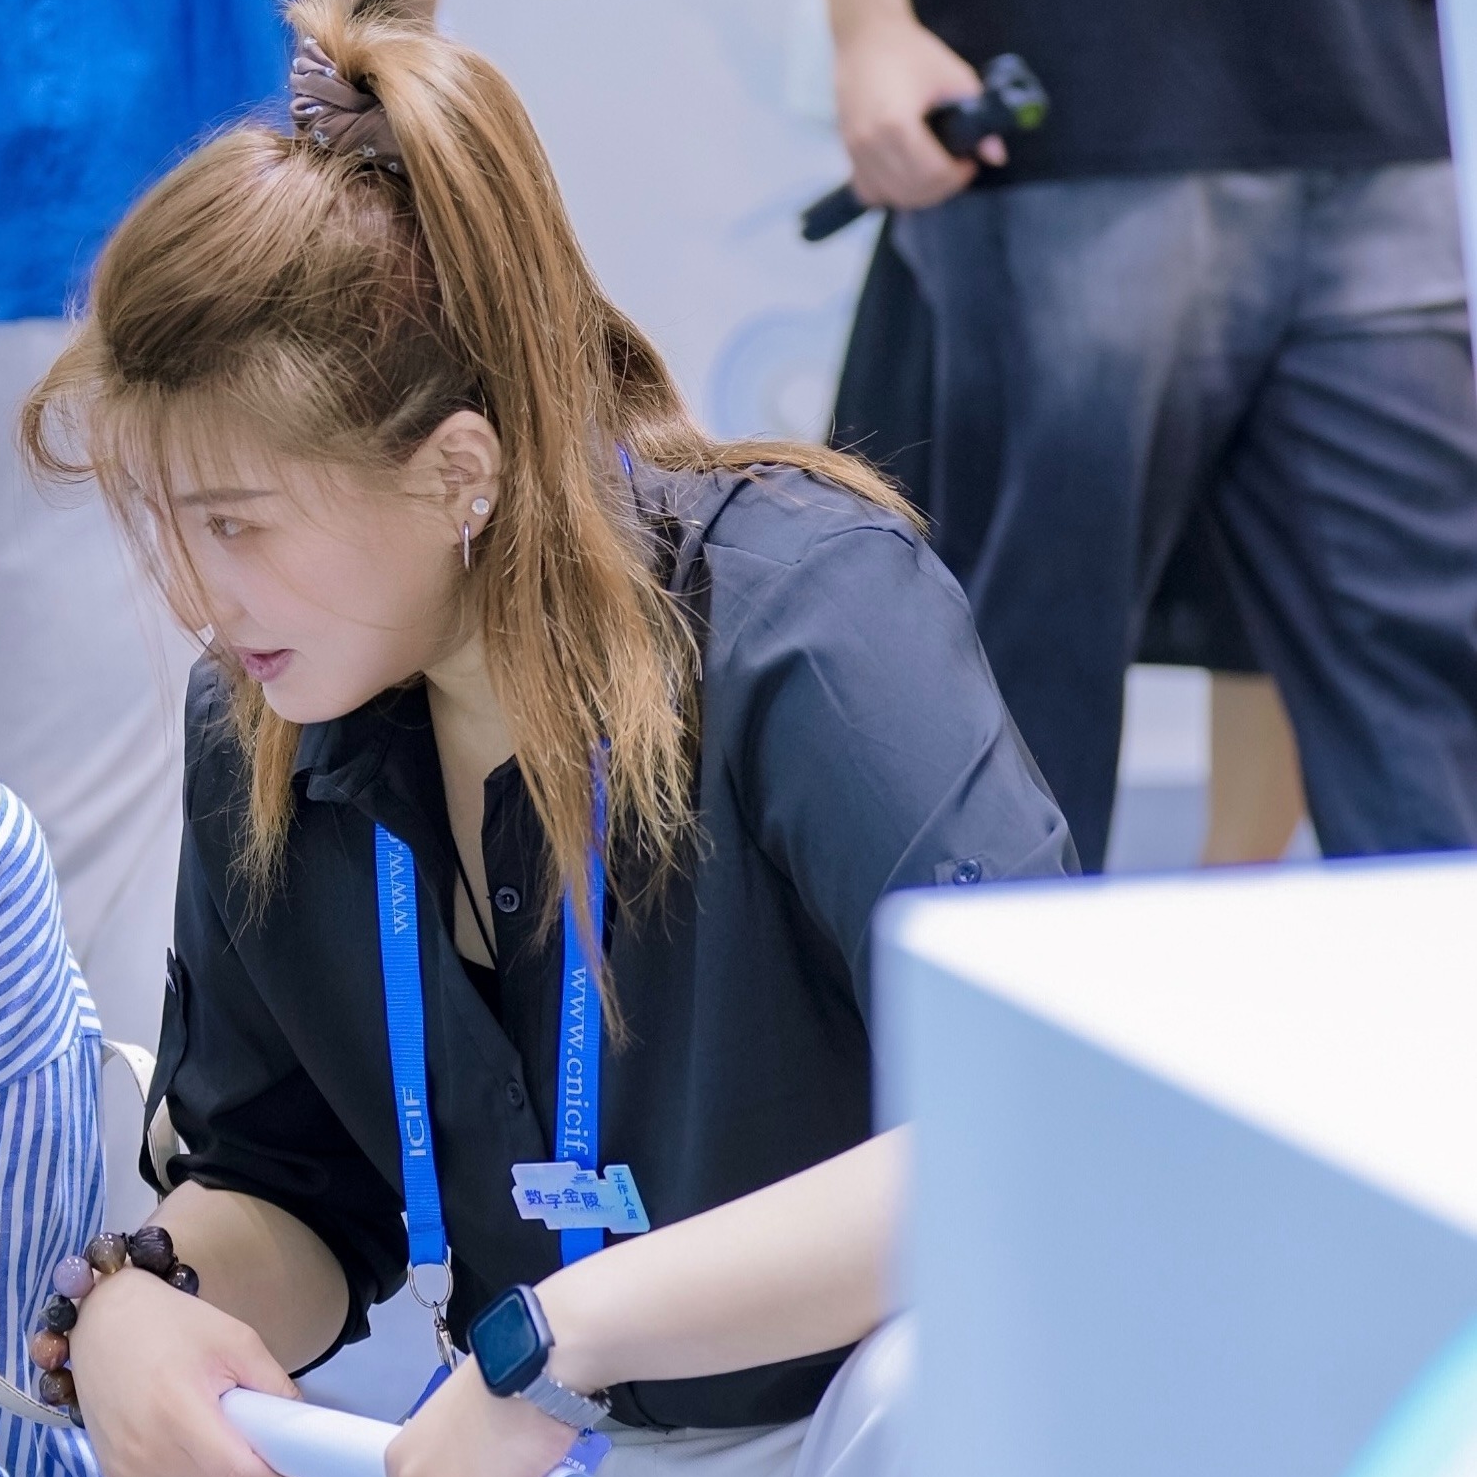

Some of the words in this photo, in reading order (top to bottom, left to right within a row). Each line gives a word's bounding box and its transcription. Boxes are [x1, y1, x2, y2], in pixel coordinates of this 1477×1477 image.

[402, 1086, 427, 1157] ICIF
[524, 1187, 601, 1210] 数字金陵
[613, 1172, 639, 1220] 工作人员
